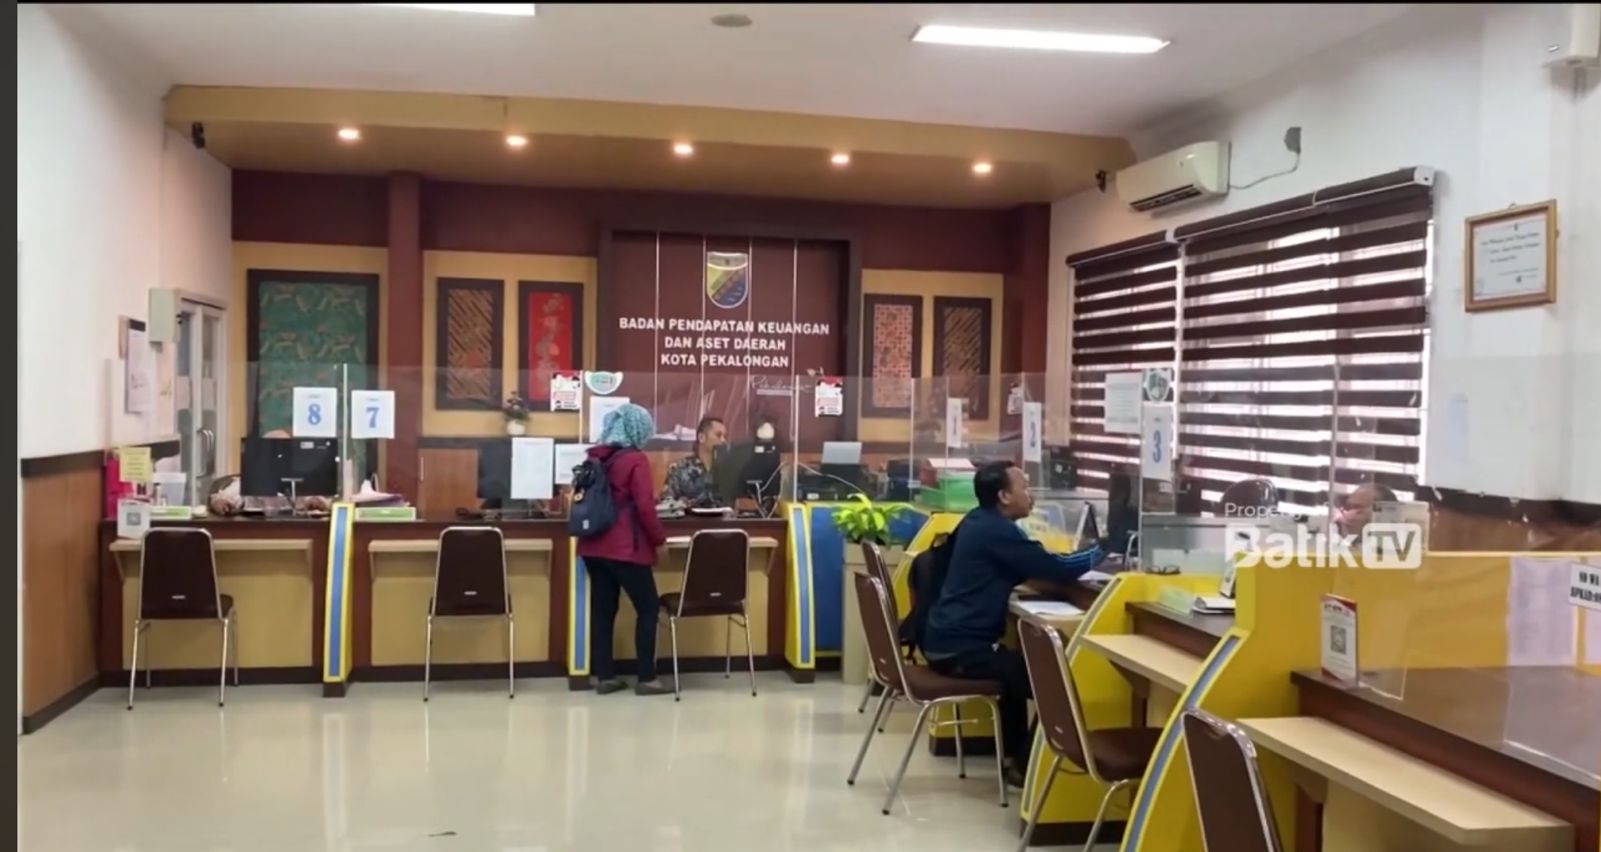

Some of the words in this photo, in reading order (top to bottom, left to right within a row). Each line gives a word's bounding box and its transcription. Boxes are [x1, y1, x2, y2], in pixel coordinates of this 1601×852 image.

[619, 317, 665, 330] BADAN
[669, 319, 754, 332] PENDAPATAN
[758, 321, 830, 335] KEUANGAN
[664, 336, 692, 349] DAN
[696, 337, 730, 349] ASET
[734, 338, 786, 350] DAERAH
[661, 354, 697, 366] KOTA
[701, 354, 789, 368] PEKALONGAN
[307, 403, 321, 425] 8
[366, 406, 380, 428] 7
[1030, 421, 1037, 448] 2
[1153, 430, 1162, 463] 3
